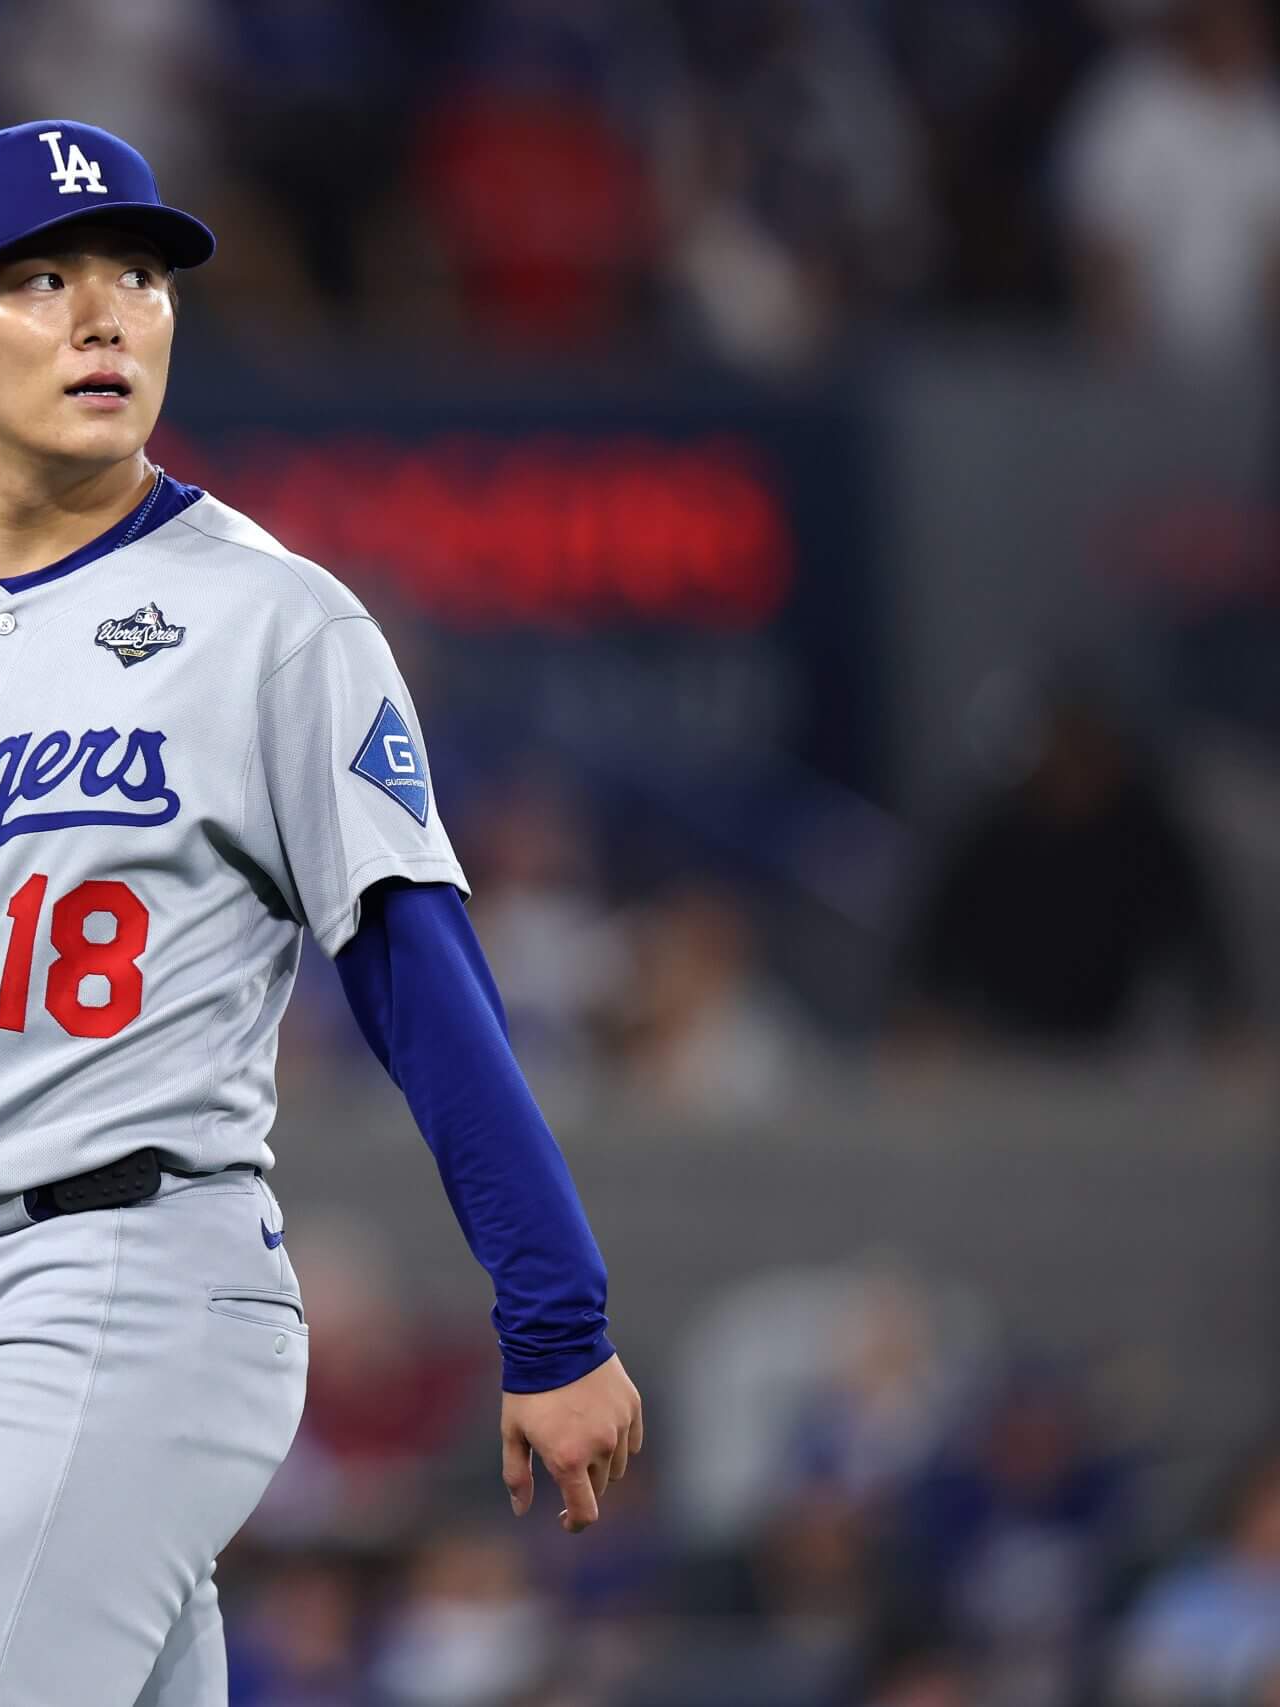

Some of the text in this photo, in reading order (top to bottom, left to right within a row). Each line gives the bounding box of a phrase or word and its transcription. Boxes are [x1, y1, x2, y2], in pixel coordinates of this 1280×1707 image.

[38, 131, 108, 194] LA
[97, 619, 180, 648] World Series
[382, 735, 416, 773] G
